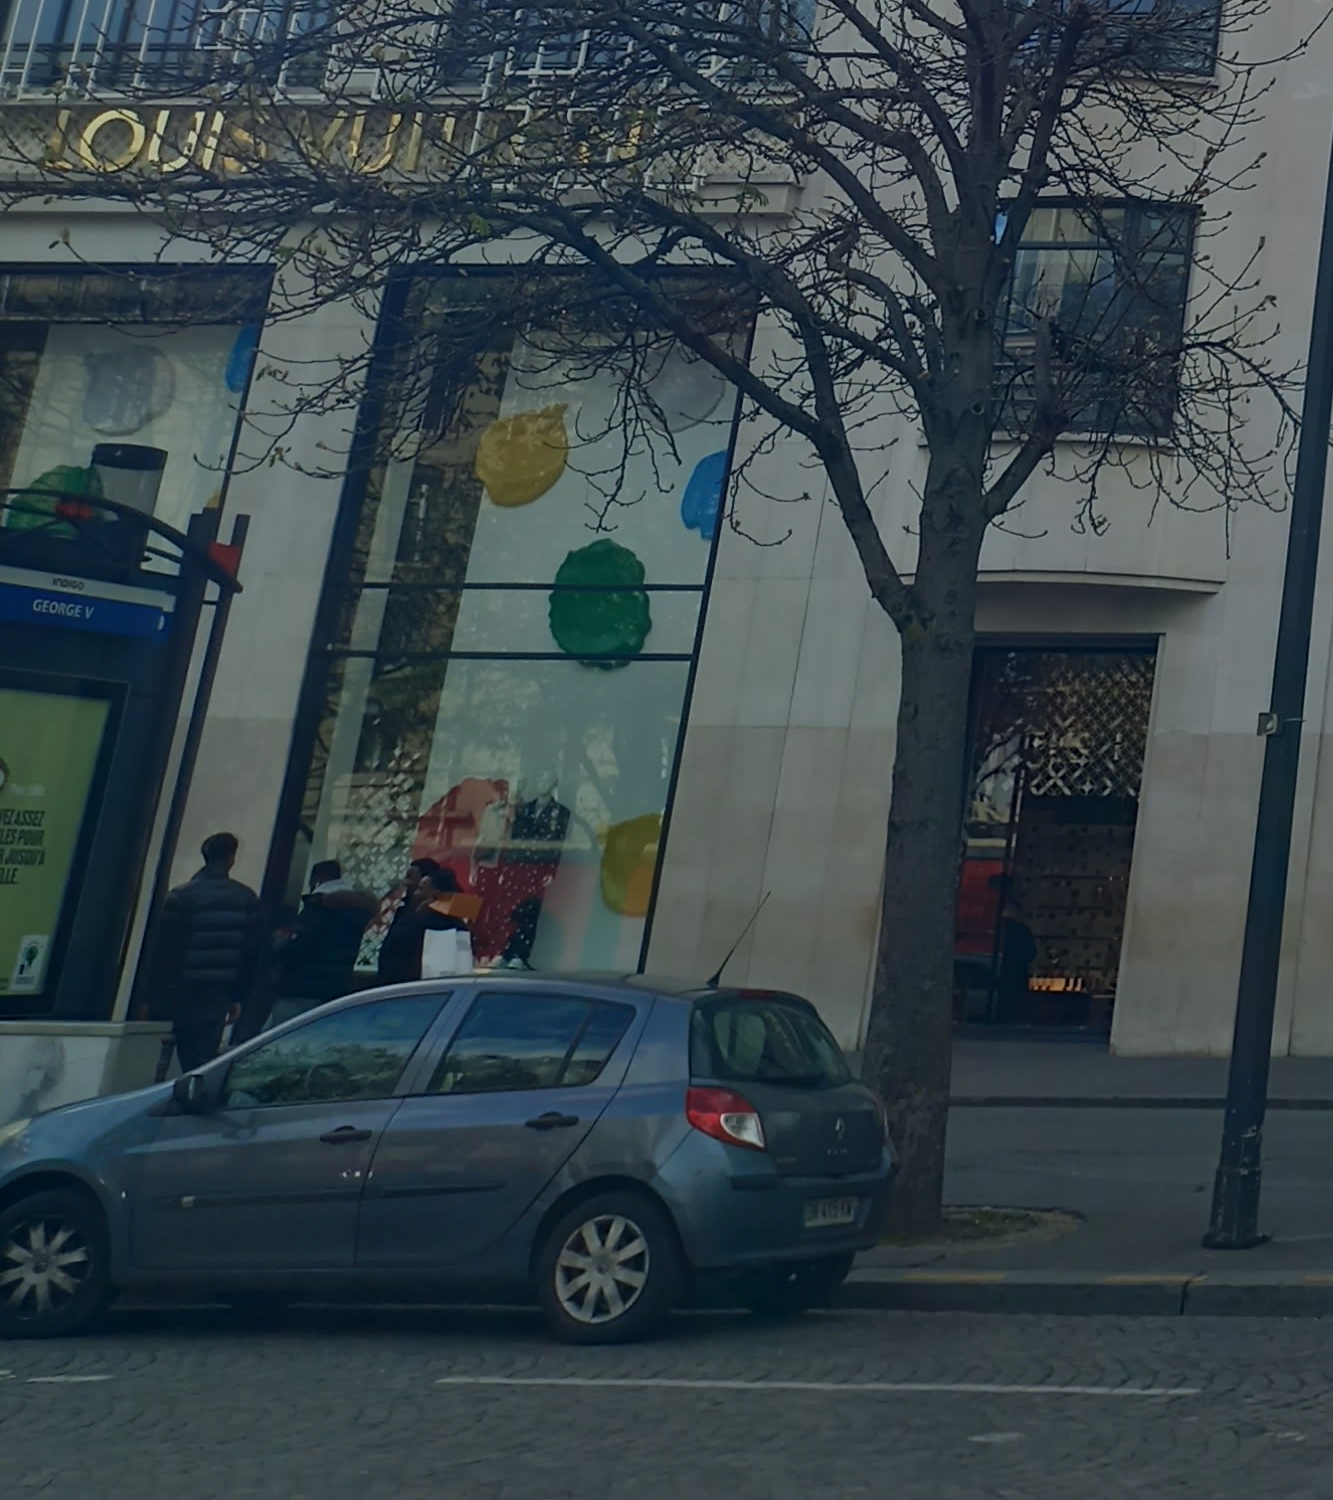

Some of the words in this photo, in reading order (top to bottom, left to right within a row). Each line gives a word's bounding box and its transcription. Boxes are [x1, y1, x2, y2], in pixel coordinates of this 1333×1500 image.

[33, 599, 82, 617] GEORGE
[85, 606, 95, 619] V
[15, 810, 44, 826] ASSEZ
